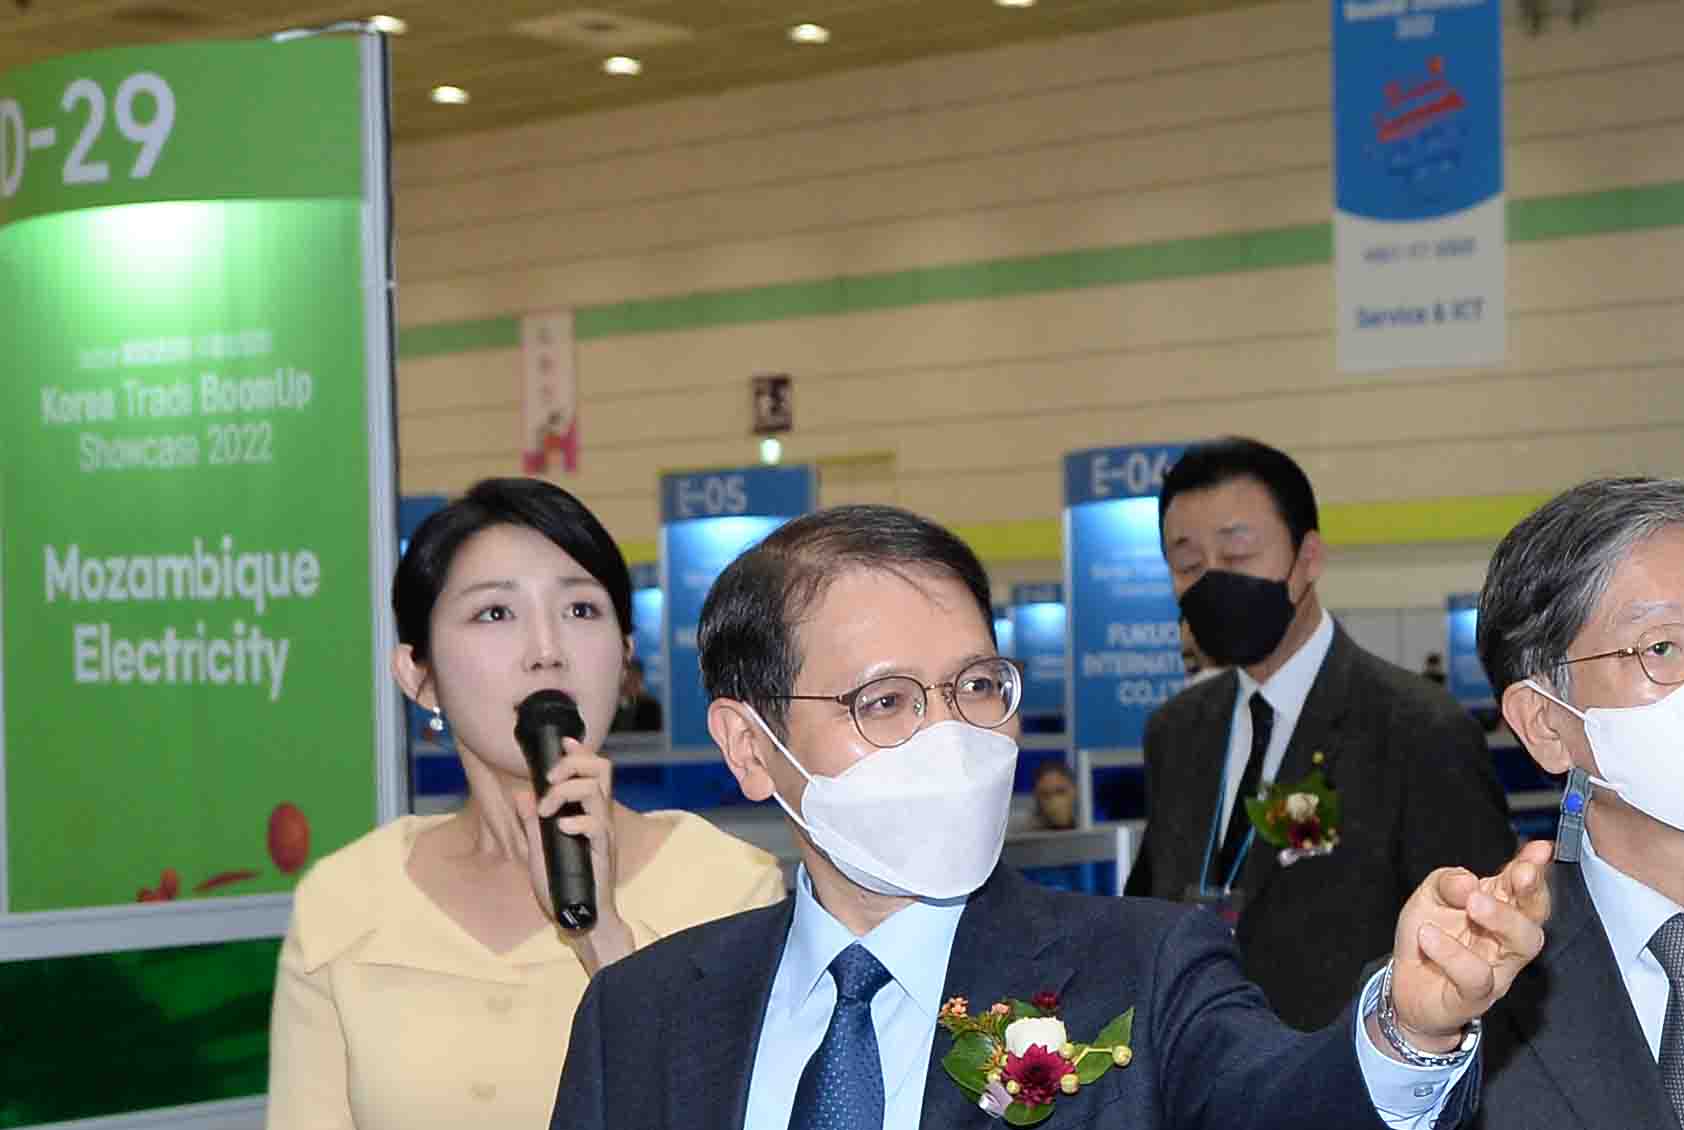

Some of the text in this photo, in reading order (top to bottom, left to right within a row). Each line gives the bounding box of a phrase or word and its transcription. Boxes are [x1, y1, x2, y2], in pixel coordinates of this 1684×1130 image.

[40, 384, 114, 424] Korea
[207, 421, 272, 466] 2022
[677, 476, 748, 516] E-05
[44, 535, 320, 616] Mozambique
[73, 619, 290, 702] Electricity
